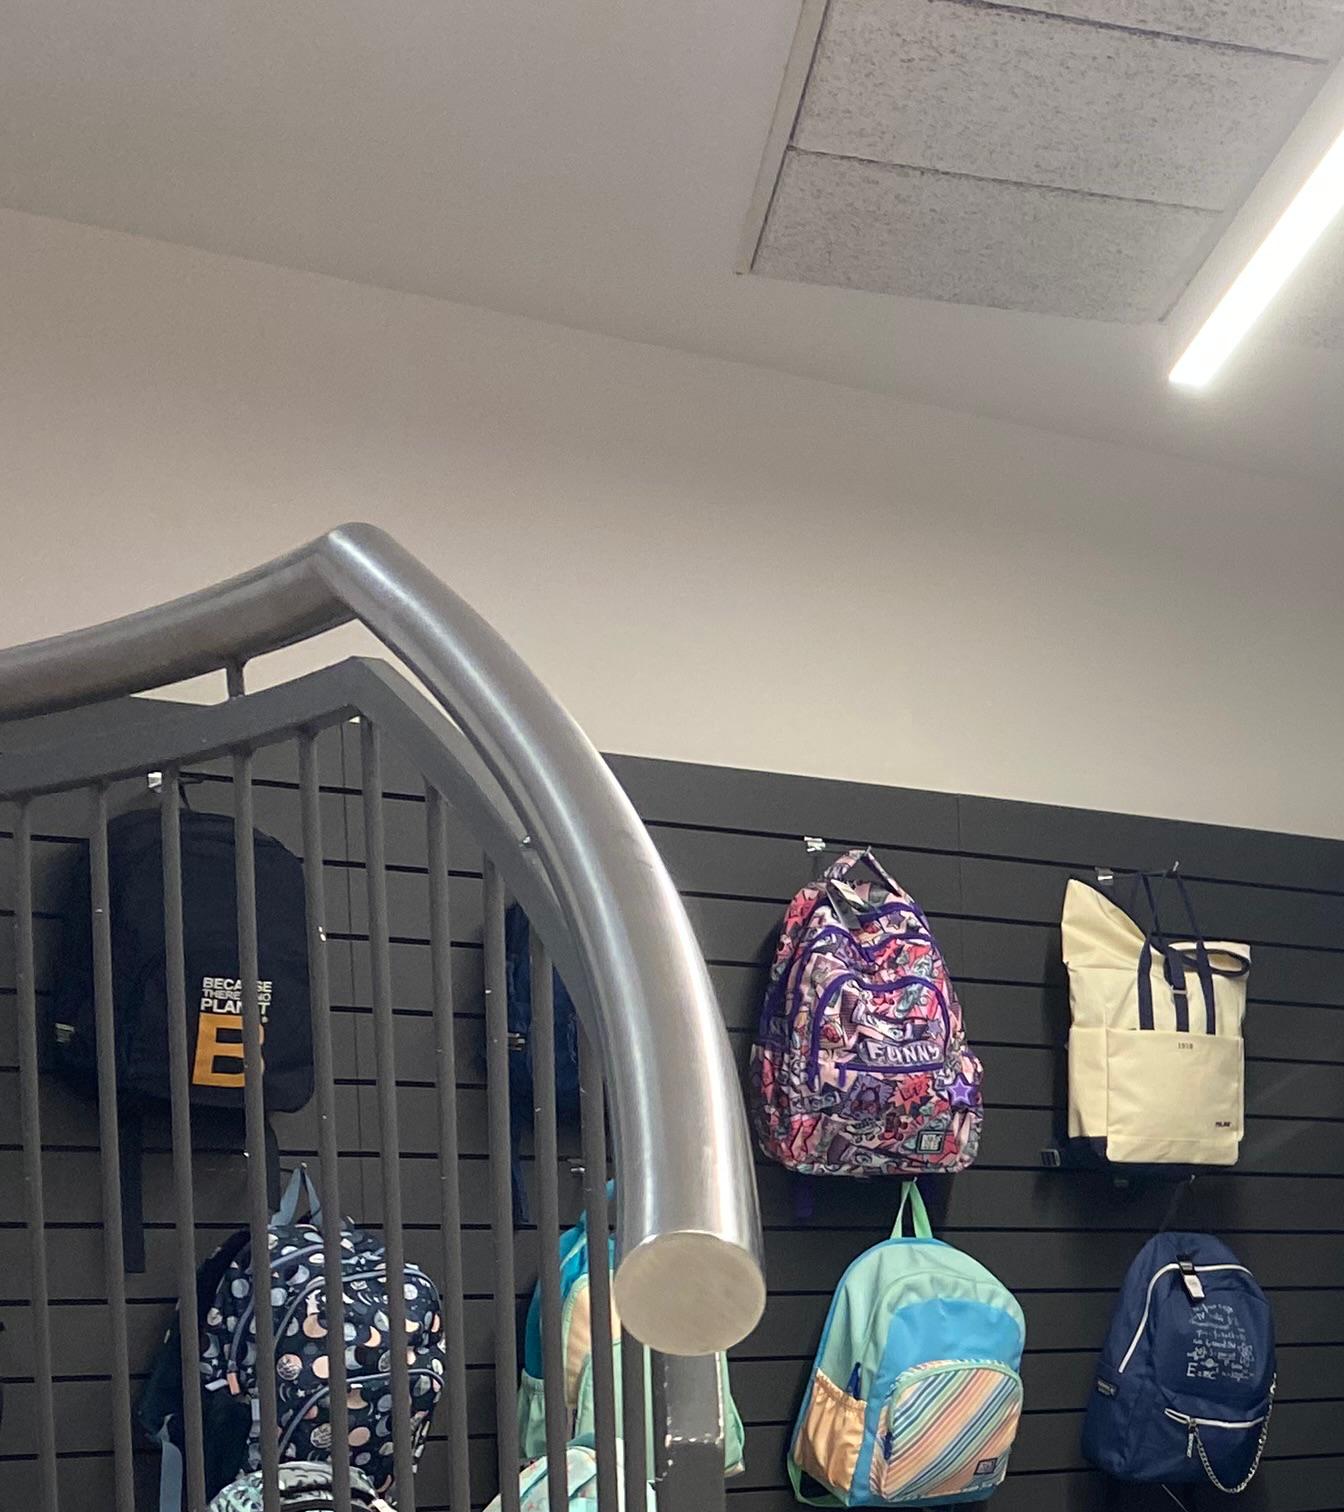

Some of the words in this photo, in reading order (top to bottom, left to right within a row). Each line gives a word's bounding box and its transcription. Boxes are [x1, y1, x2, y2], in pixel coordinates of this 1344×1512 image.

[203, 976, 273, 993] BECASE
[200, 997, 271, 1015] PLANT
[865, 1040, 940, 1063] FUNNY
